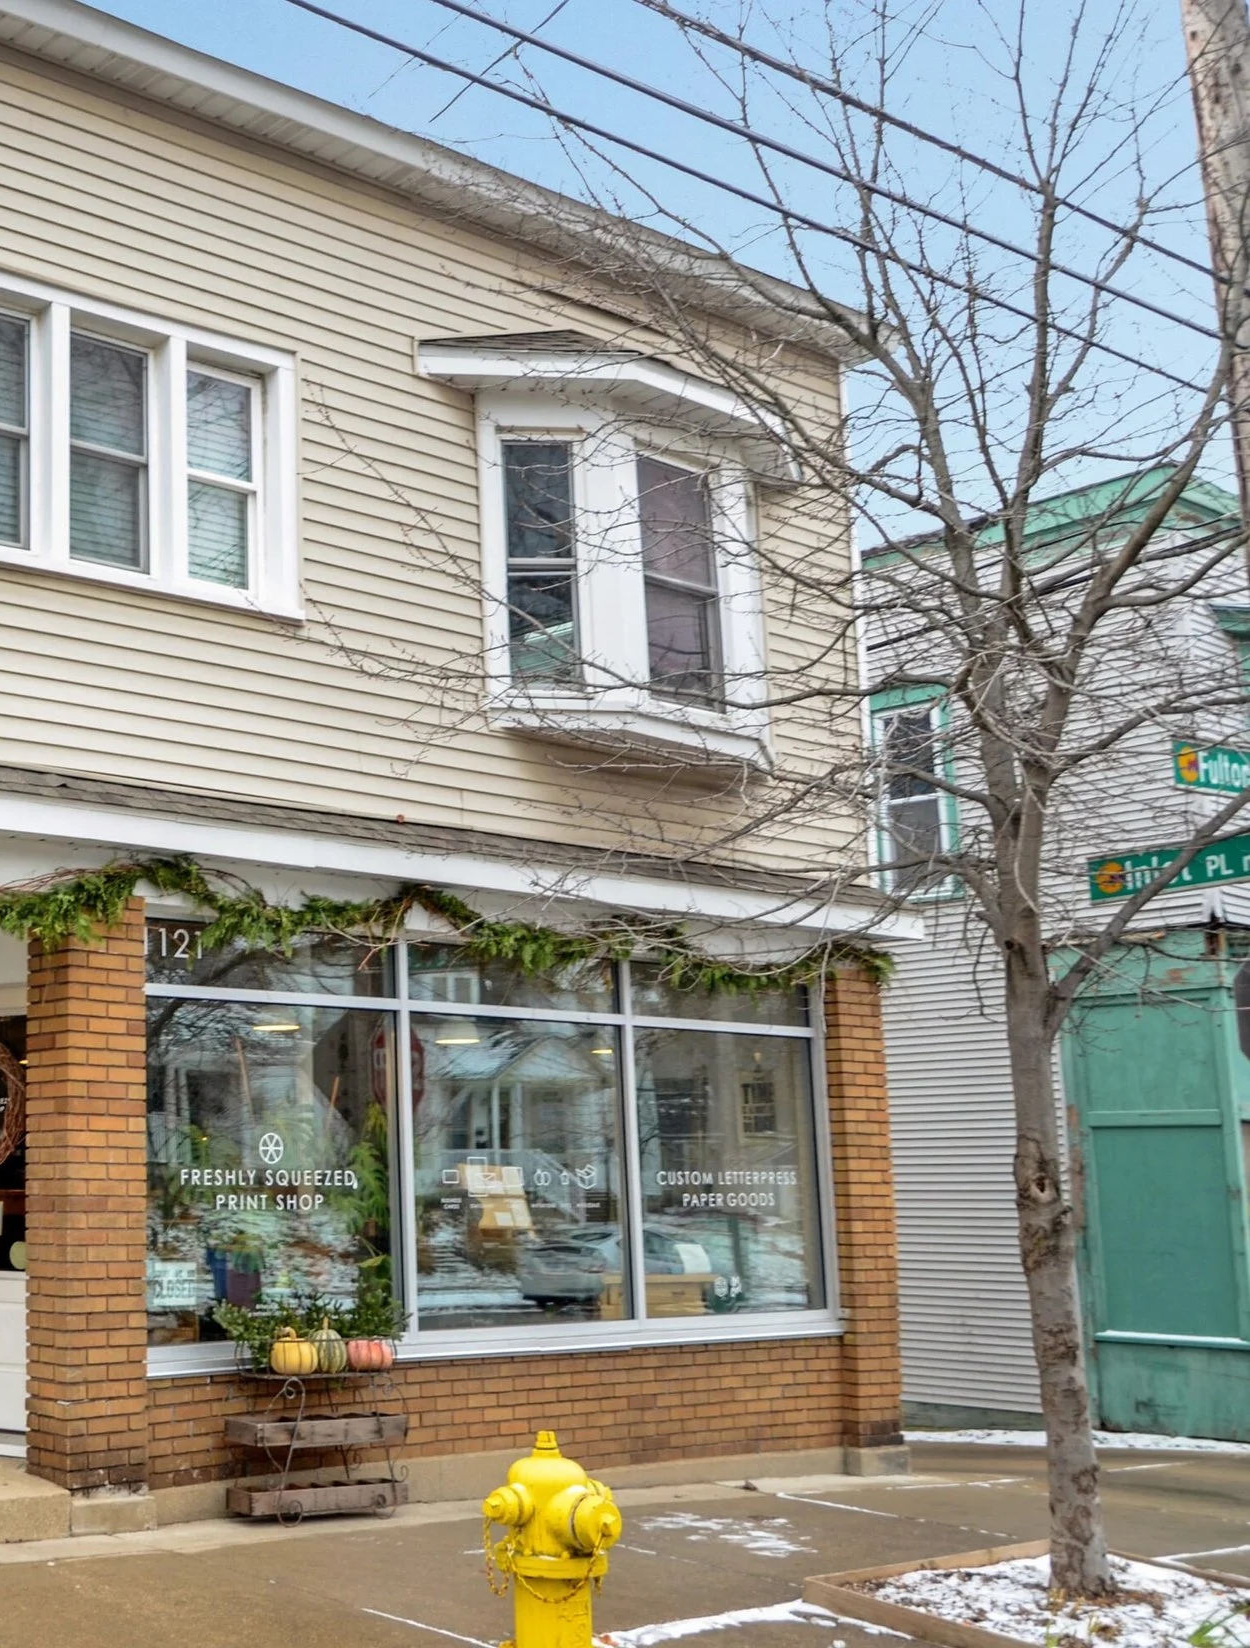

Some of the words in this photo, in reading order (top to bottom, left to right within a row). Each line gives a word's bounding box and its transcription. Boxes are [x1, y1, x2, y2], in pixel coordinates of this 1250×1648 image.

[1205, 854, 1235, 877] PL
[180, 1169, 257, 1186] FRESHLY
[265, 1169, 355, 1187] SQUEEZED
[656, 1171, 713, 1186] CUSTOM
[717, 1171, 798, 1186] LETTERPRESS
[215, 1194, 268, 1211] PRINT
[276, 1194, 325, 1211] SHOP
[682, 1193, 724, 1207] PAPER
[726, 1192, 775, 1207] GOODS
